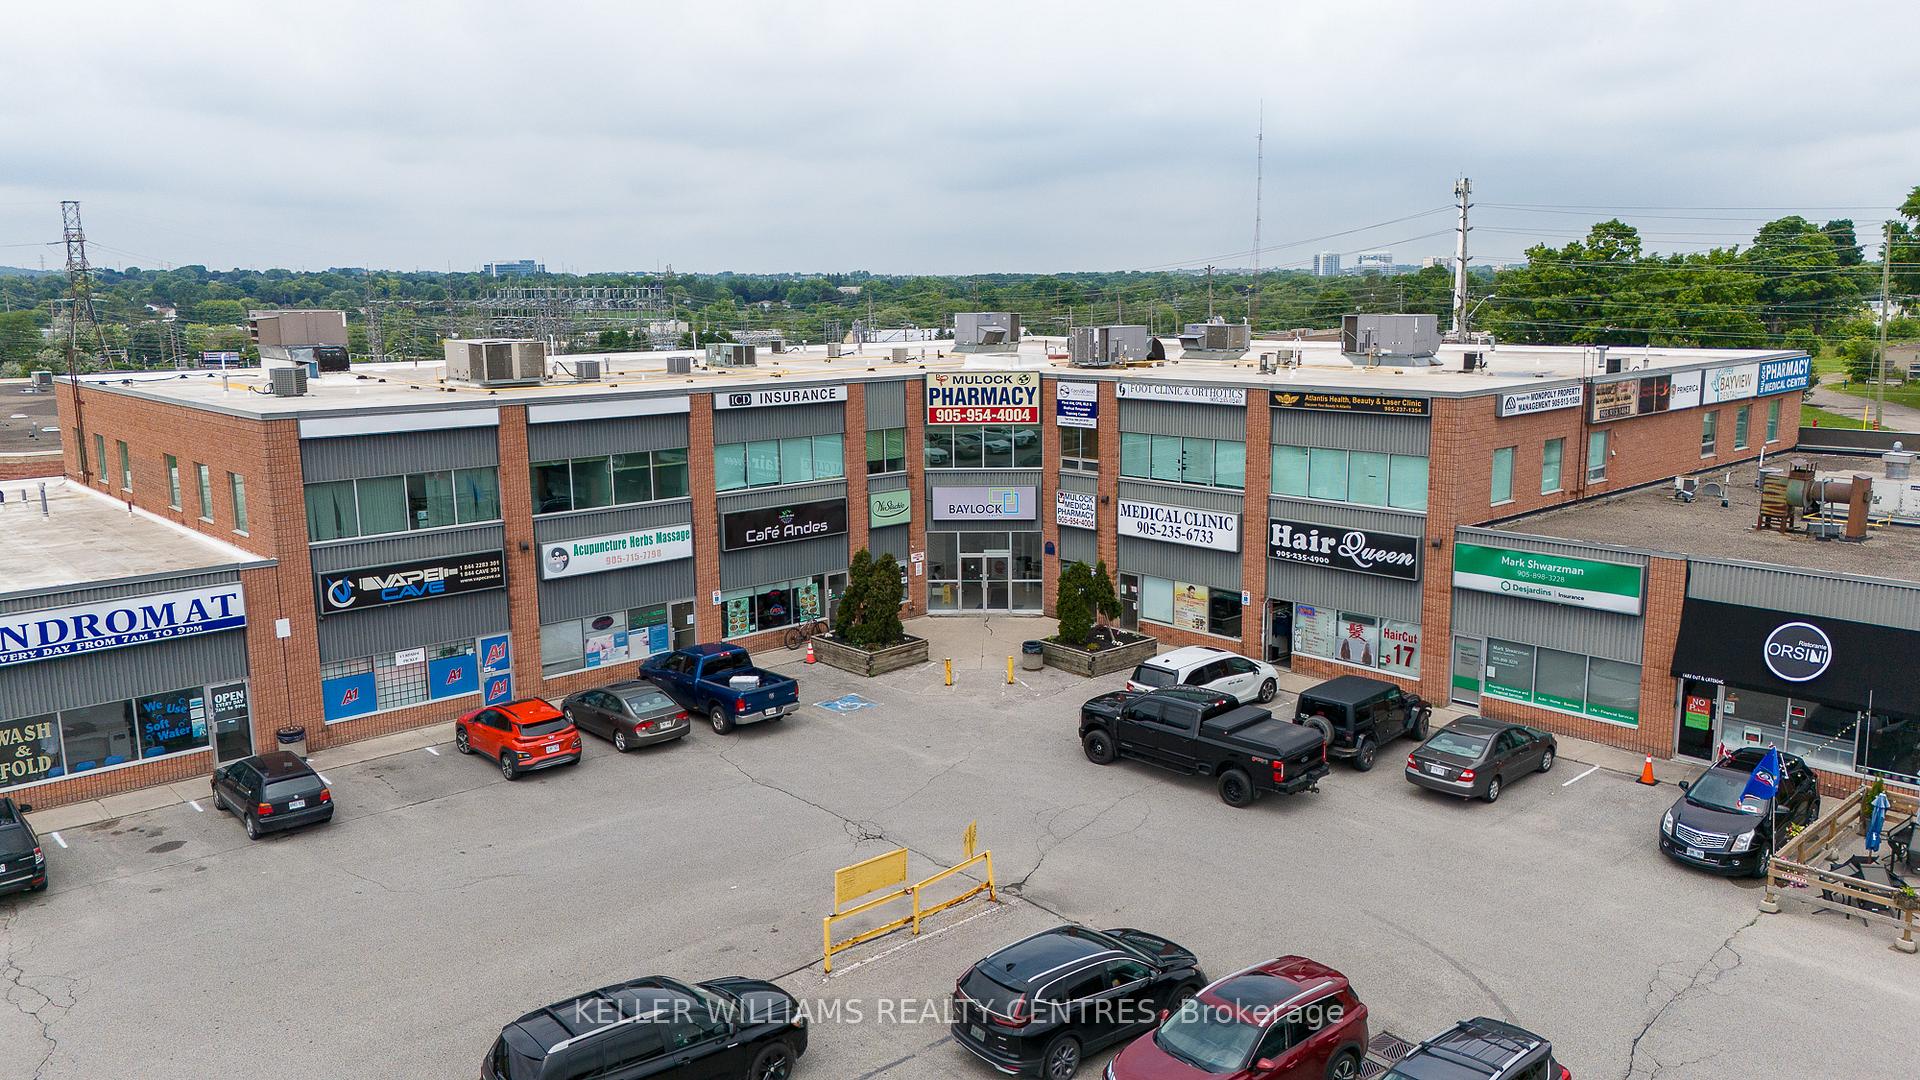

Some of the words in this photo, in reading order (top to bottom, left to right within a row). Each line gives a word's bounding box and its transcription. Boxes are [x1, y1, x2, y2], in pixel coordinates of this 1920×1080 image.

[1766, 358, 1809, 380] PHARMACY
[952, 375, 1013, 385] MULOCK
[1720, 373, 1752, 391] BAYVIEW
[1764, 380, 1785, 392] MEDICAL
[1786, 376, 1806, 388] CENTRE
[731, 395, 751, 406] ICD
[760, 388, 836, 404] INSURANCE
[929, 386, 1037, 406] PHARMACY
[1130, 384, 1152, 394] FOOT
[1154, 385, 1183, 396] CLINIC
[1192, 387, 1243, 399] ORTHOTICS
[1530, 390, 1557, 401] MONOPOLY
[1558, 387, 1580, 397] PROPERTY
[1677, 384, 1699, 394] PRIMERICA
[1305, 394, 1328, 402] Atlantis
[1329, 395, 1351, 404] Health,
[1352, 397, 1374, 406] Beauty
[1382, 398, 1400, 406] Laser
[1402, 399, 1422, 407] Clinic
[1518, 401, 1551, 412] MANAGEMENT
[936, 408, 1031, 422] 905-954-4004
[1064, 493, 1094, 503] MULOCK
[1065, 501, 1094, 511] MEDICAL
[948, 504, 1002, 514] BAYLOCK
[1058, 507, 1095, 519] PHARMACY
[1120, 503, 1181, 524] MEDICAL
[1184, 511, 1234, 531] CLINIC
[746, 525, 780, 542] Café
[784, 520, 828, 539] Andes
[1137, 521, 1214, 544] 905-235-6733
[573, 539, 627, 557] Acupuncture
[629, 534, 654, 549] Herbs
[656, 529, 690, 545] Massage
[1271, 524, 1336, 554] Hair
[1338, 531, 1415, 568] Queen
[1276, 550, 1330, 564] 905-235-4900
[1501, 555, 1525, 568] Mark
[1527, 559, 1584, 576] Shwarzman
[373, 567, 440, 590] VAPE
[1517, 570, 1565, 583] 905-898-3228
[382, 580, 445, 601] CAVE
[1512, 583, 1552, 597] Desjardins
[1558, 592, 1585, 601] Insurance
[43, 643, 71, 656] DAY
[77, 637, 116, 650] FROM
[122, 633, 149, 643] 7AM
[153, 629, 173, 639] TO
[177, 624, 203, 634] 9PM
[1384, 628, 1417, 644] HairCut
[486, 642, 507, 666] A1
[1768, 642, 1827, 664] ORSINI
[1798, 640, 1827, 651] Ristorante
[1394, 644, 1415, 667] 17
[446, 667, 462, 685] A1
[214, 690, 244, 704] OPEN
[342, 687, 359, 705] A1
[488, 679, 507, 700] A1
[144, 701, 163, 712] We
[166, 703, 188, 713] Use
[1692, 698, 1706, 707] NO
[0, 721, 52, 746] WASH
[145, 719, 169, 733] Soft
[157, 726, 191, 740] Water
[15, 745, 33, 758] &
[0, 755, 52, 780] FOLD
